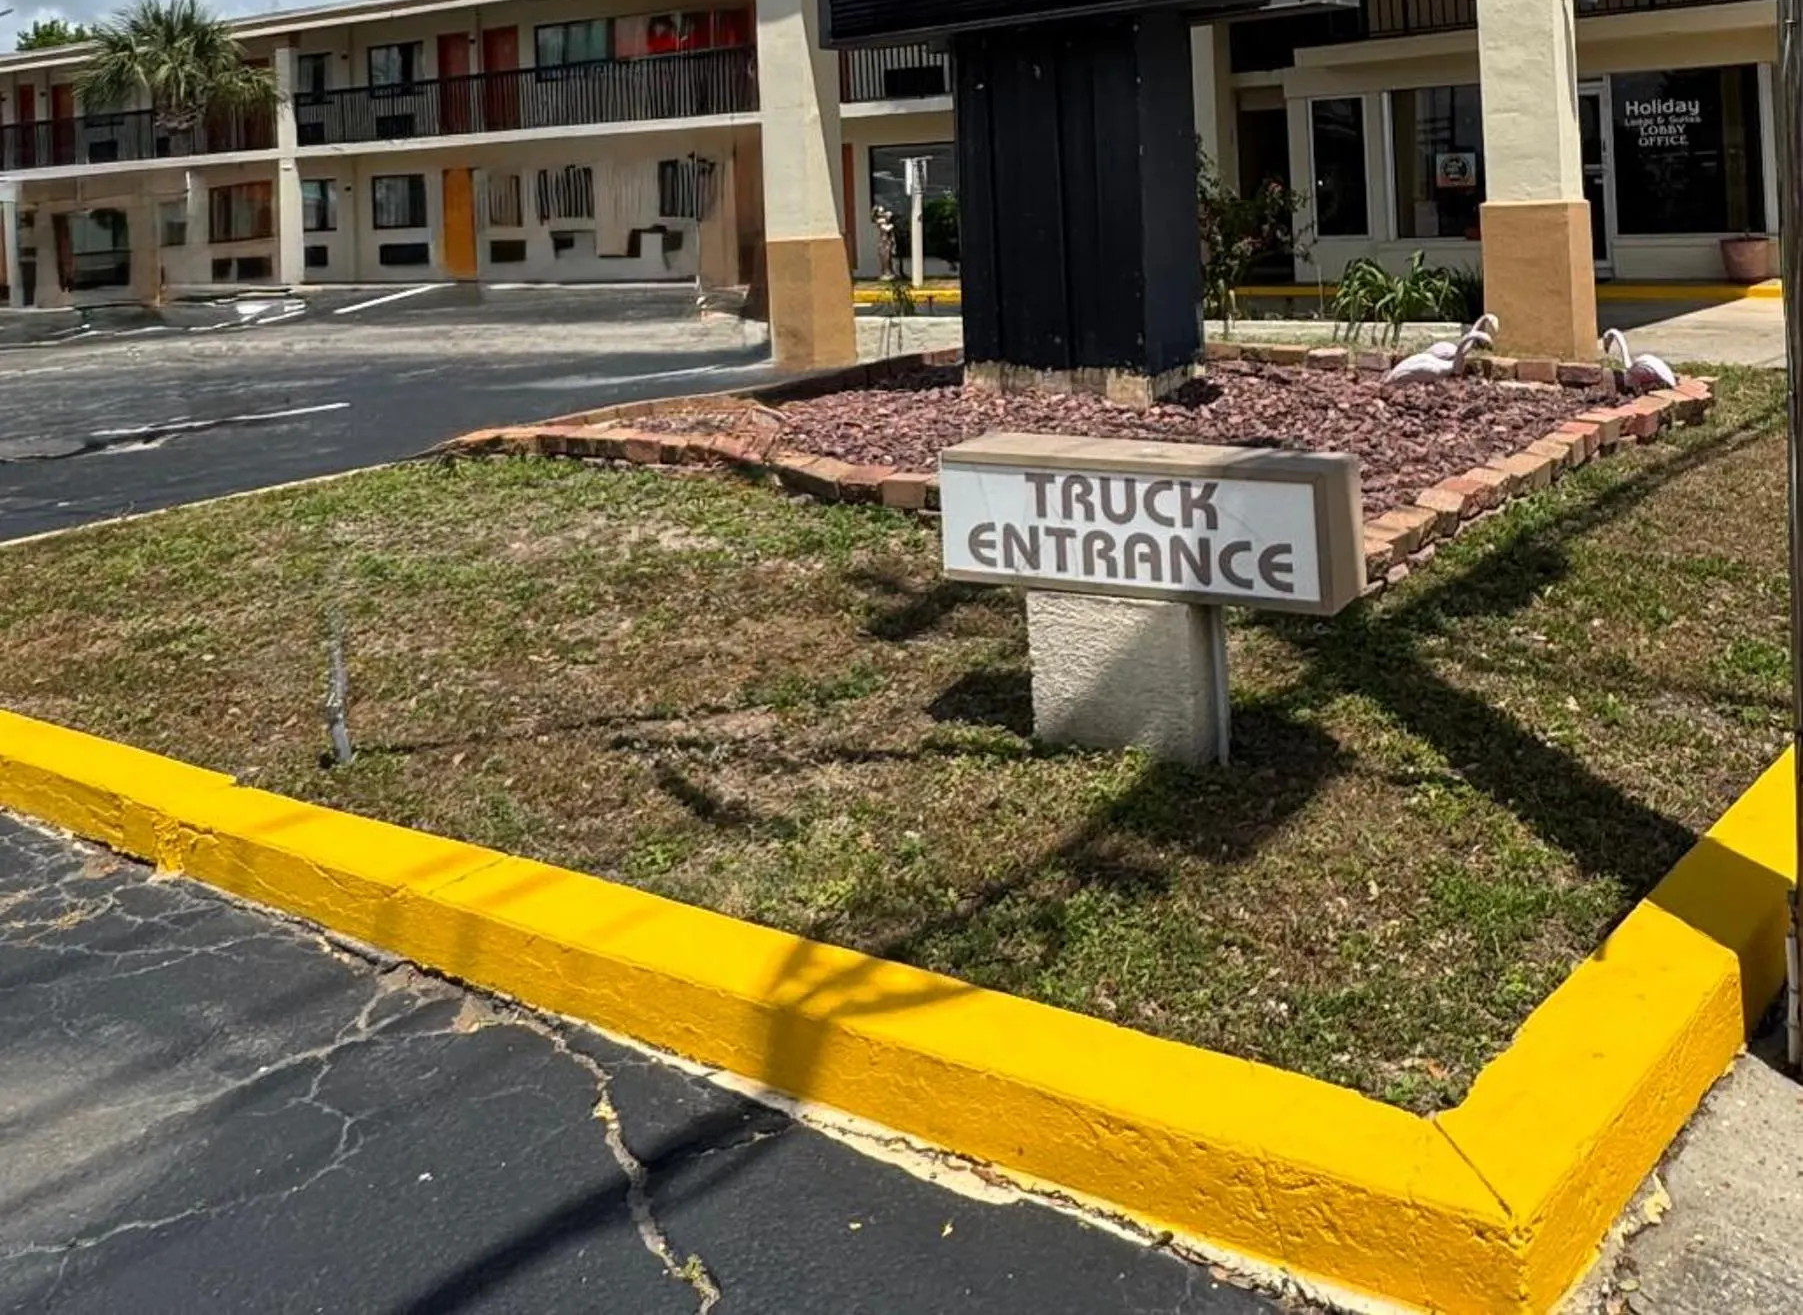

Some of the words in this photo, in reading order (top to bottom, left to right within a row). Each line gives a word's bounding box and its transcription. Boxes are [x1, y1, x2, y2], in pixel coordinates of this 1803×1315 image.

[1625, 98, 1701, 116] Holiday
[1639, 124, 1687, 137] LOBBY
[1637, 134, 1690, 148] OFFICE
[1025, 471, 1220, 532] TRUCK
[967, 521, 1295, 594] ENTRANCE
